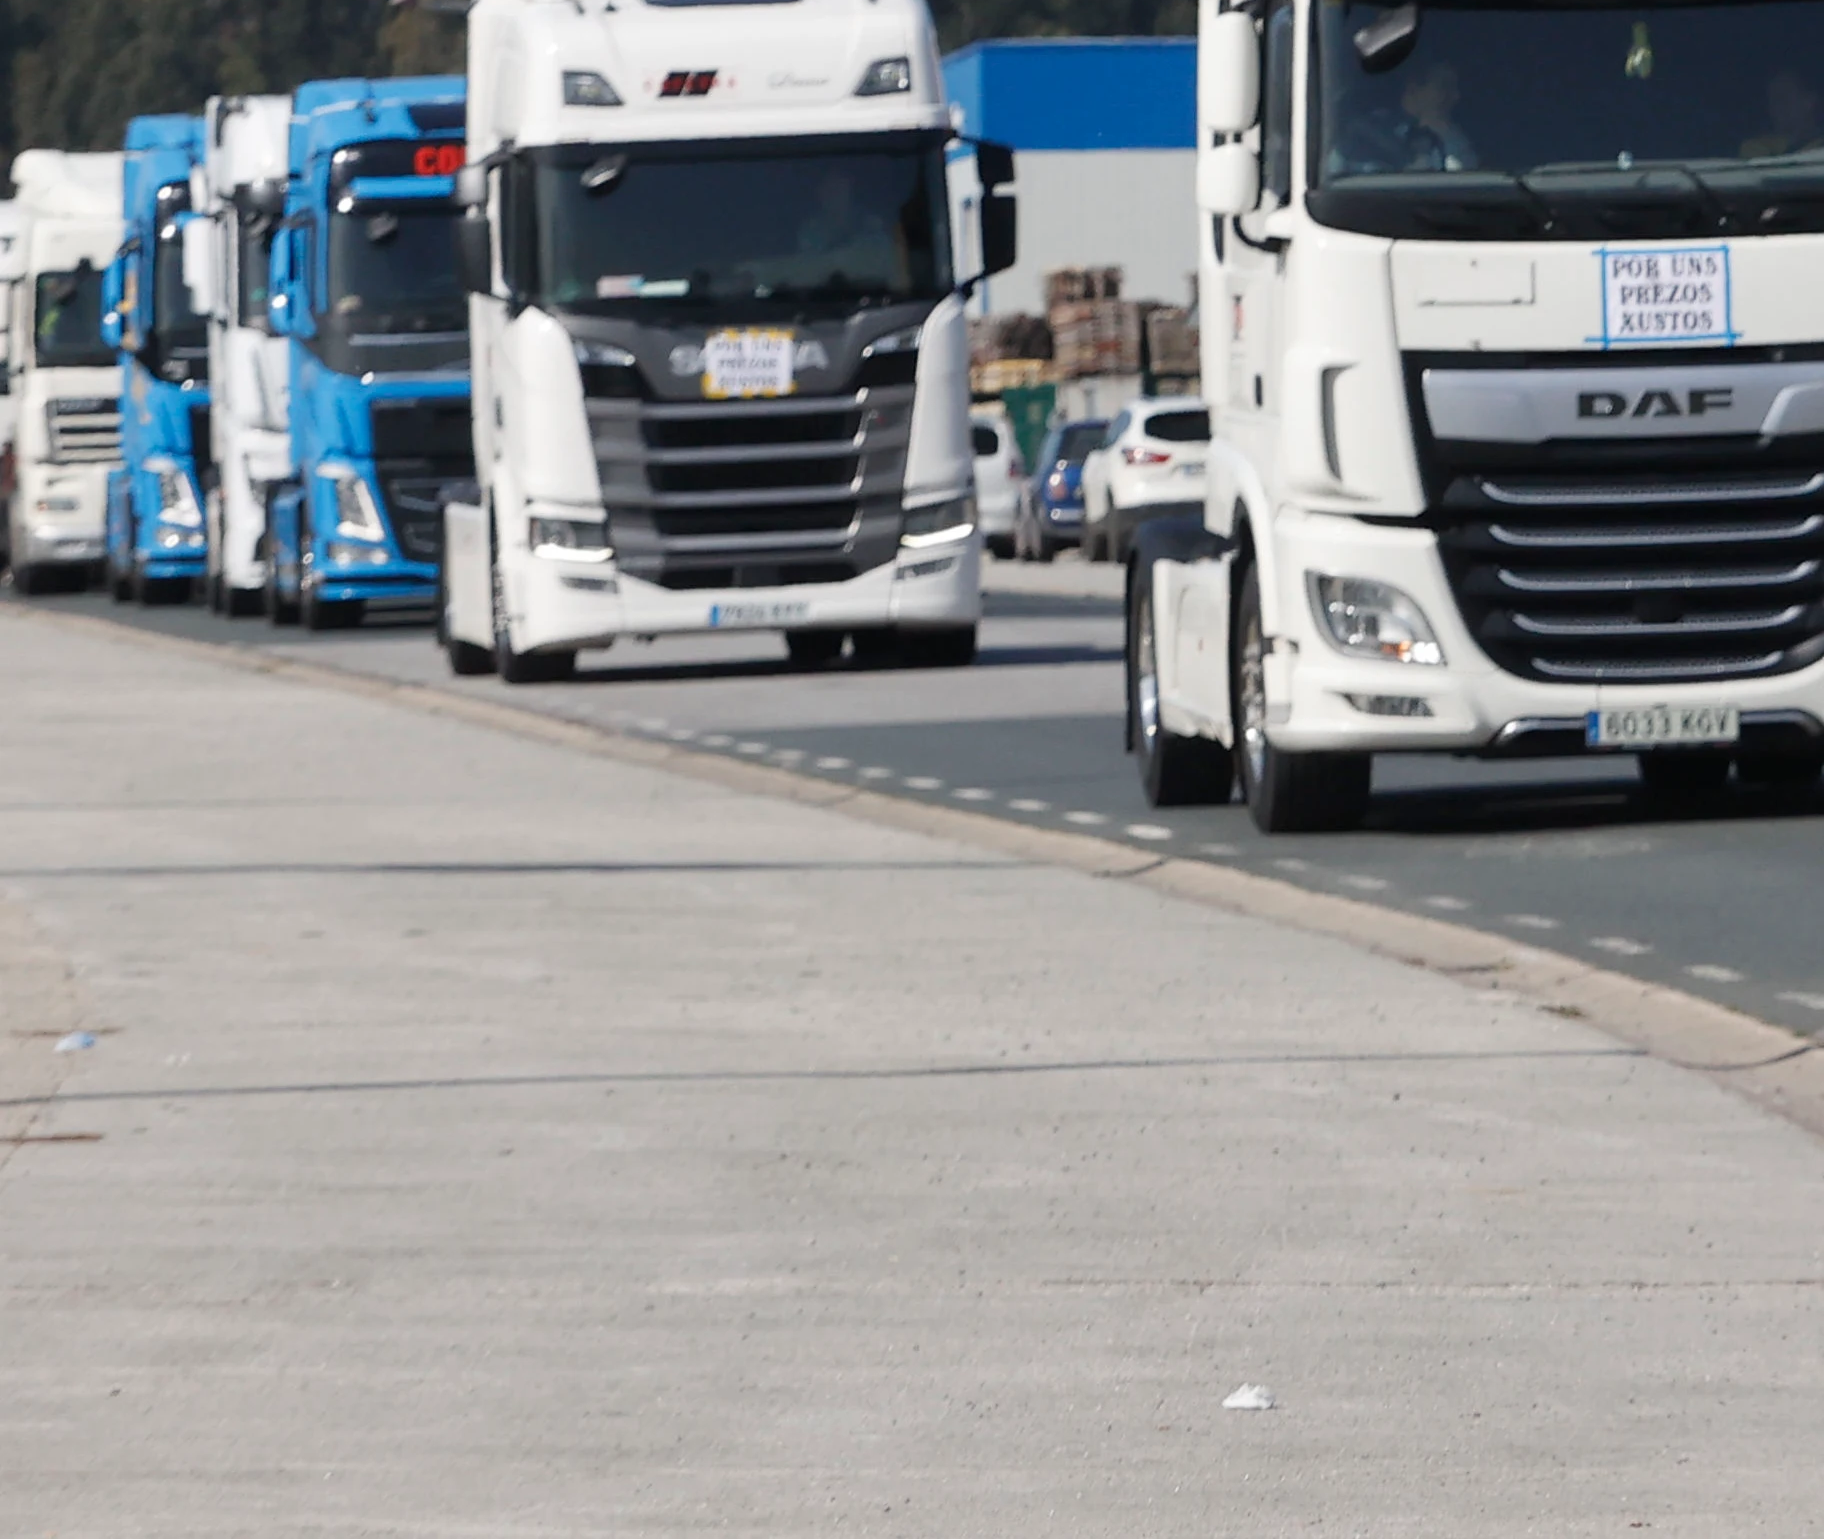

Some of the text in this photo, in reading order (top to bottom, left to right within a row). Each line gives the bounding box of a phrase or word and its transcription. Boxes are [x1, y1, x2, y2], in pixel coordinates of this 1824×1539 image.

[1612, 256, 1717, 278] POR UNS
[1620, 282, 1712, 305] PREZOS
[1619, 309, 1712, 333] XUSTOS
[1577, 387, 1733, 418] DAF
